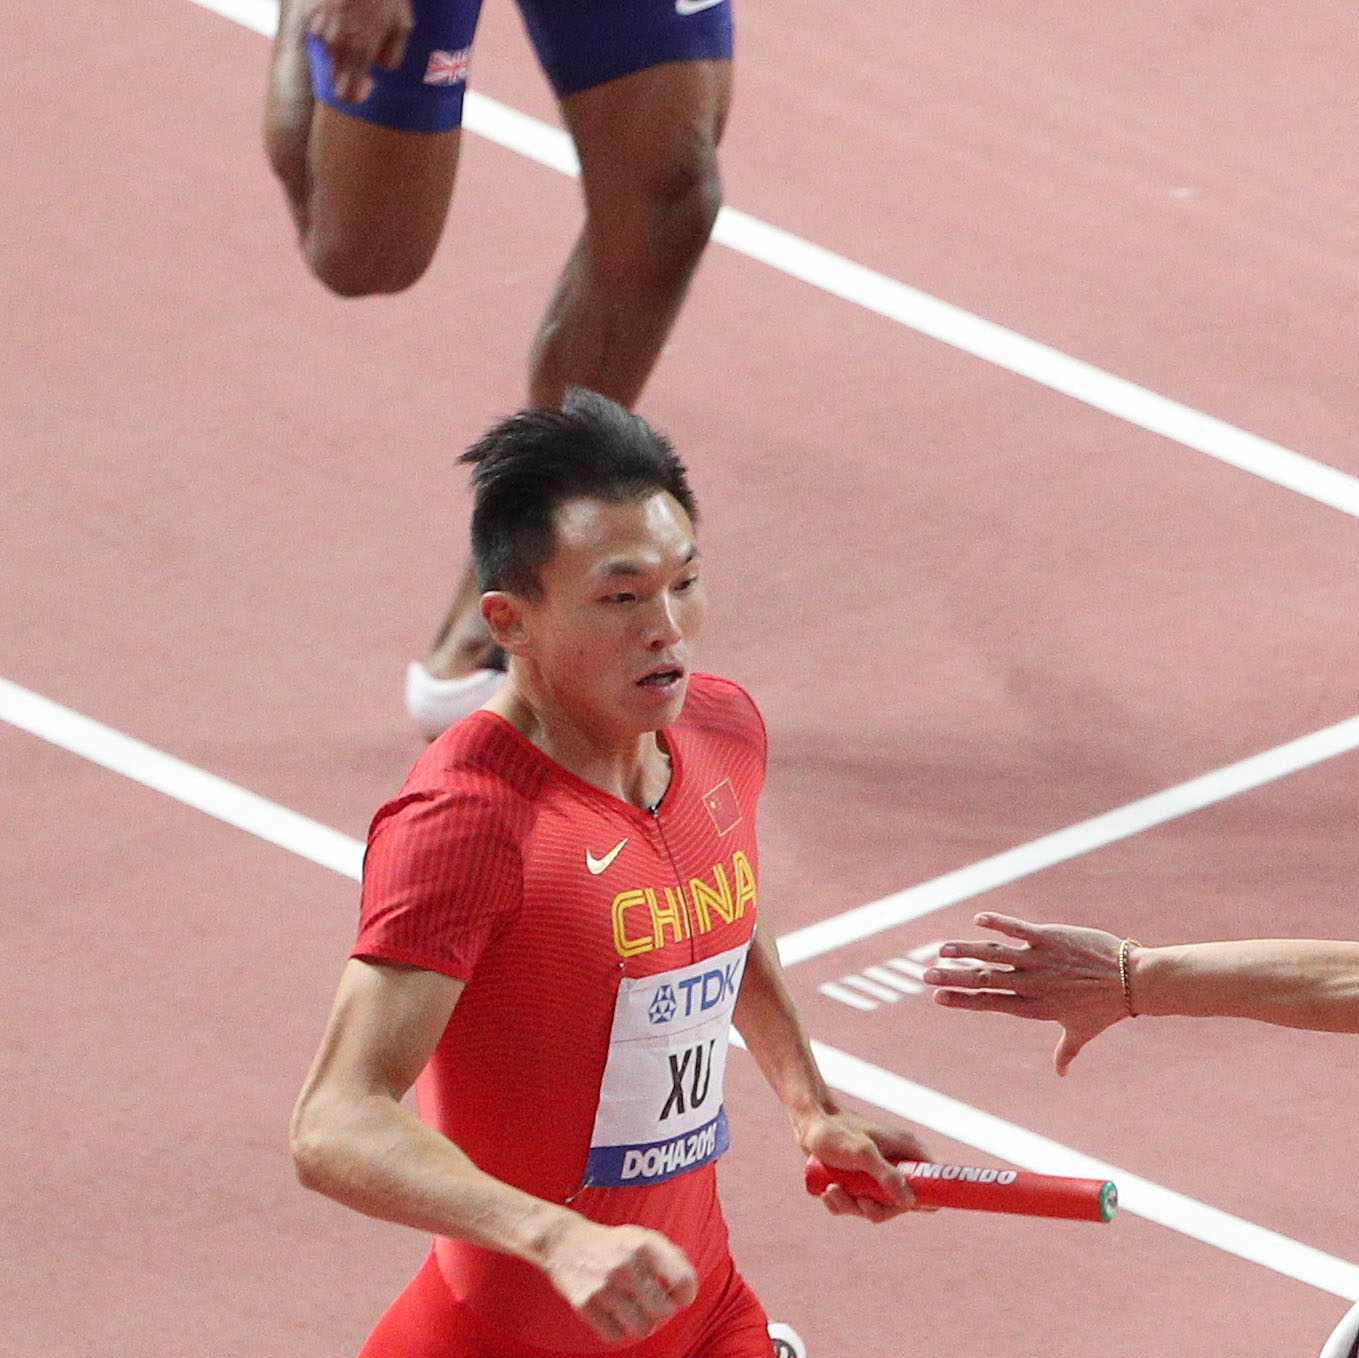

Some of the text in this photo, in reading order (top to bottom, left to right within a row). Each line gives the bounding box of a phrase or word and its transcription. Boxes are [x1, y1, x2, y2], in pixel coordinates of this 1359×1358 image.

[611, 850, 757, 957] CHINA
[678, 959, 741, 1017] TDK
[659, 1038, 717, 1121] XU
[914, 1162, 1018, 1185] MONDO
